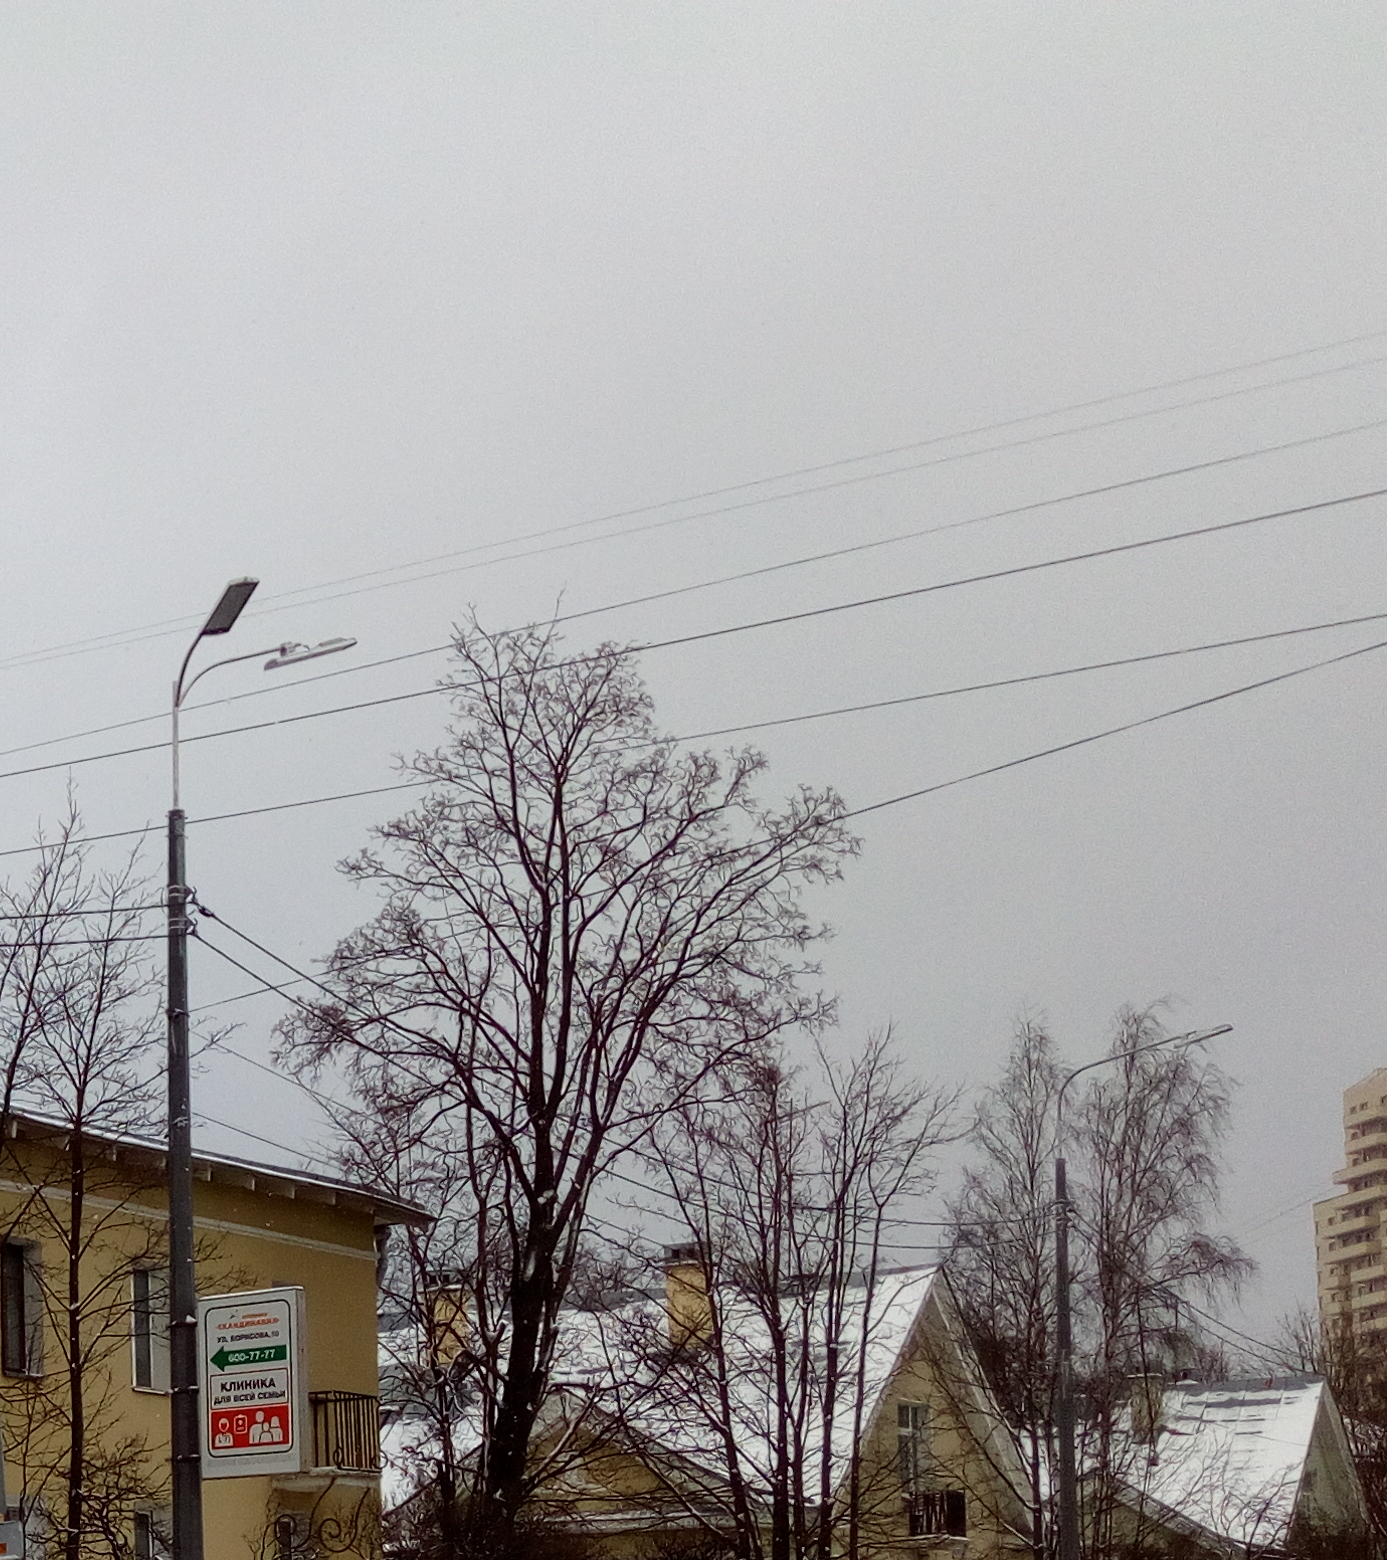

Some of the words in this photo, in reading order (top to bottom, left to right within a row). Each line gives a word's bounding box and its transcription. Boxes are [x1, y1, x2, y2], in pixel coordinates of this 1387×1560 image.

[228, 1349, 276, 1363] 600-77-77
[220, 1377, 276, 1393] КЛИНИКА
[213, 1395, 232, 1406] ДЛЯ
[233, 1391, 256, 1403] ВСЕЙ
